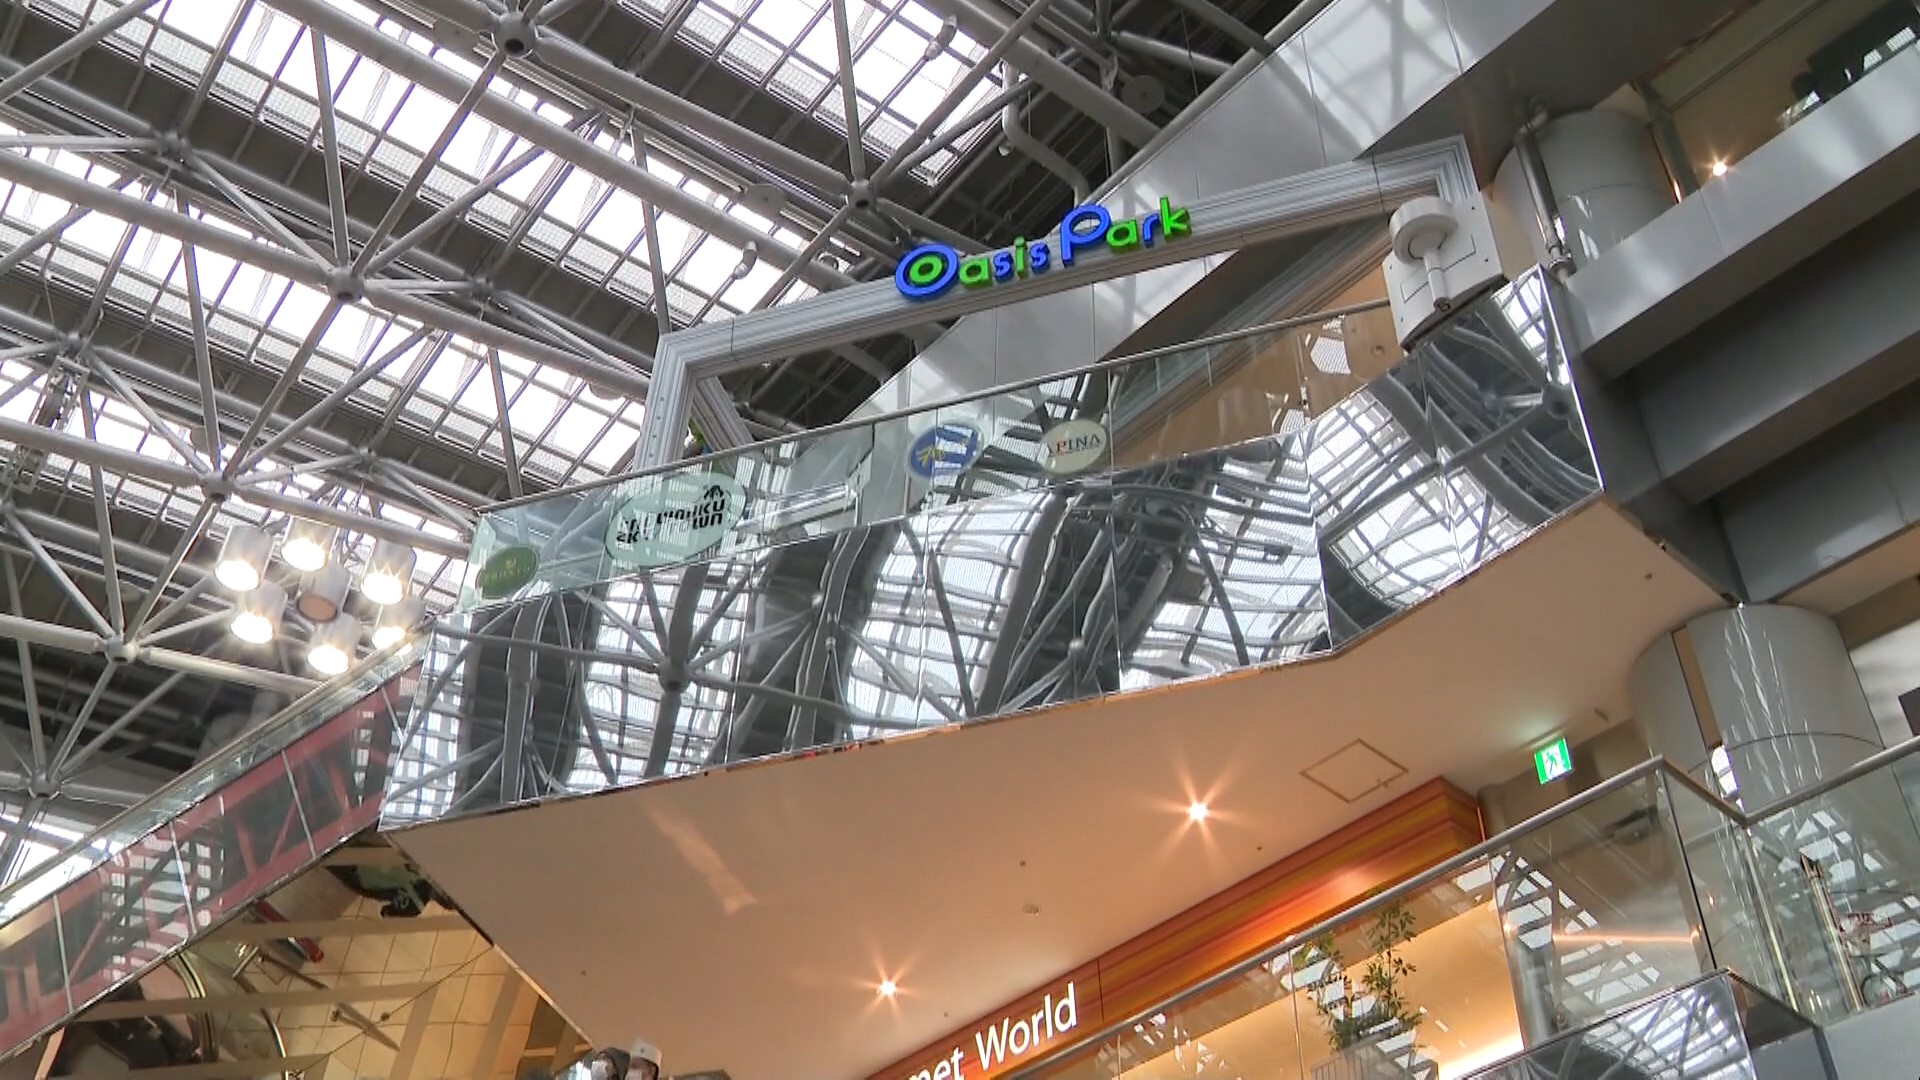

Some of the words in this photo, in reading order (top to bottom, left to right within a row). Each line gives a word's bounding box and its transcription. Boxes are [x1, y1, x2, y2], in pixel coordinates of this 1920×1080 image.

[895, 237, 1050, 298] Oasis
[1059, 196, 1191, 266] Park
[975, 981, 1078, 1071] World
